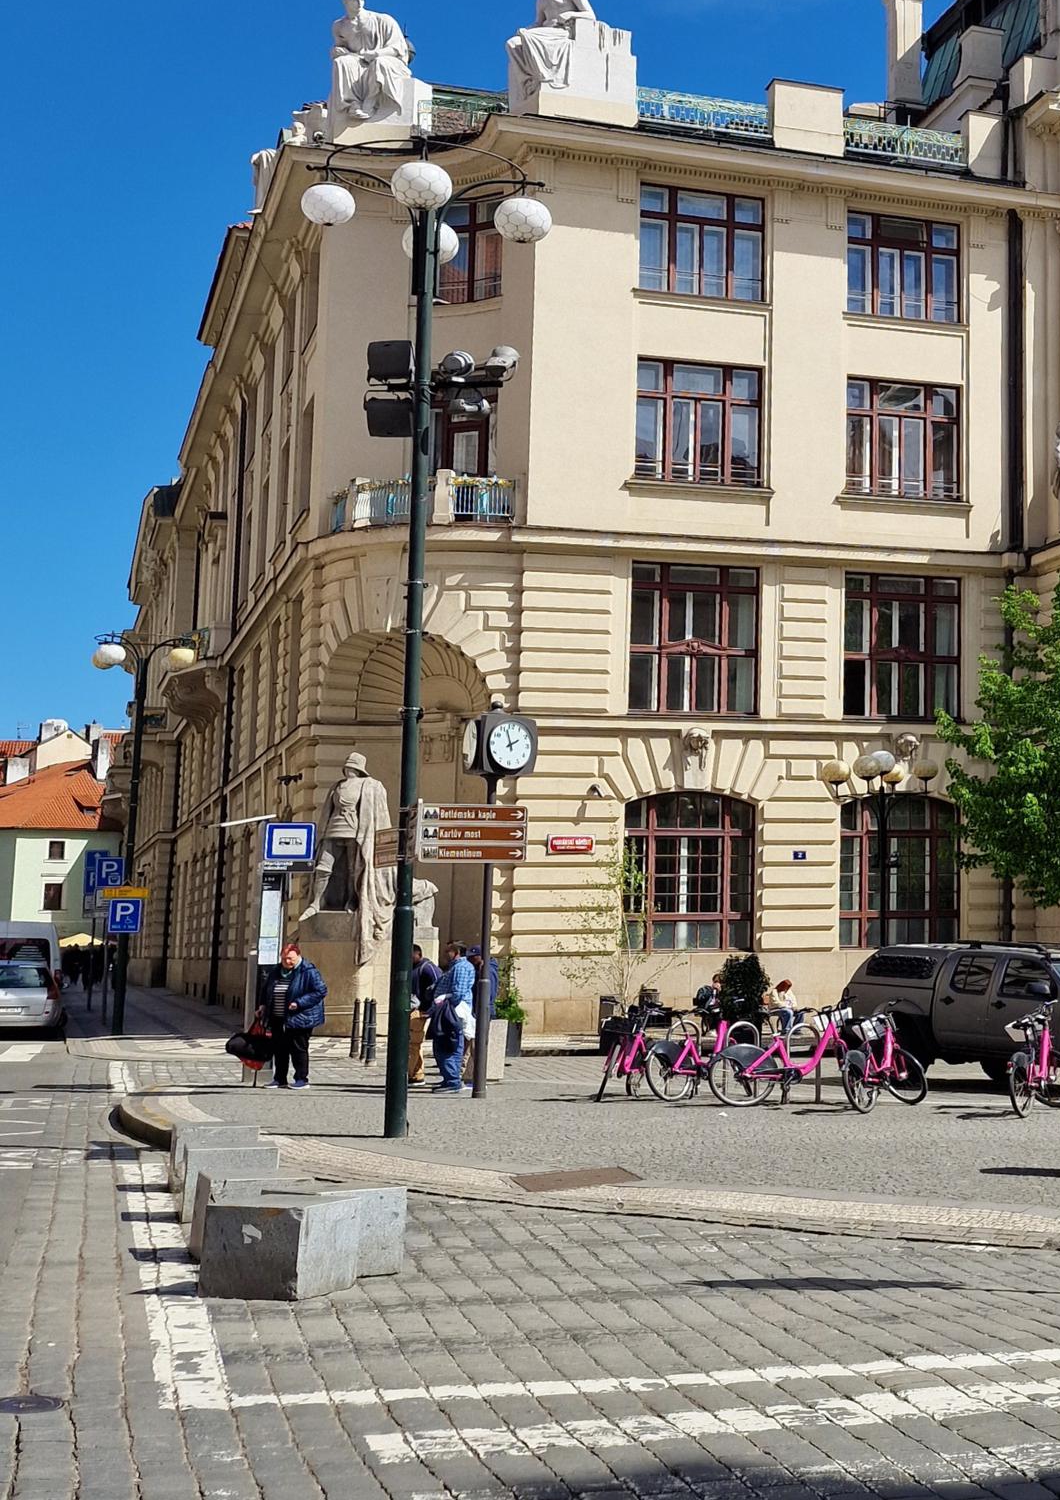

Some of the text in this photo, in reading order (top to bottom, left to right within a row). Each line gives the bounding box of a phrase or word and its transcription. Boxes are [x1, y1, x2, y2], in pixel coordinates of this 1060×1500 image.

[439, 809, 497, 821] Betlémská kaple
[439, 829, 481, 838] Karlův most
[439, 847, 482, 857] Klementinum
[115, 902, 135, 922] P
